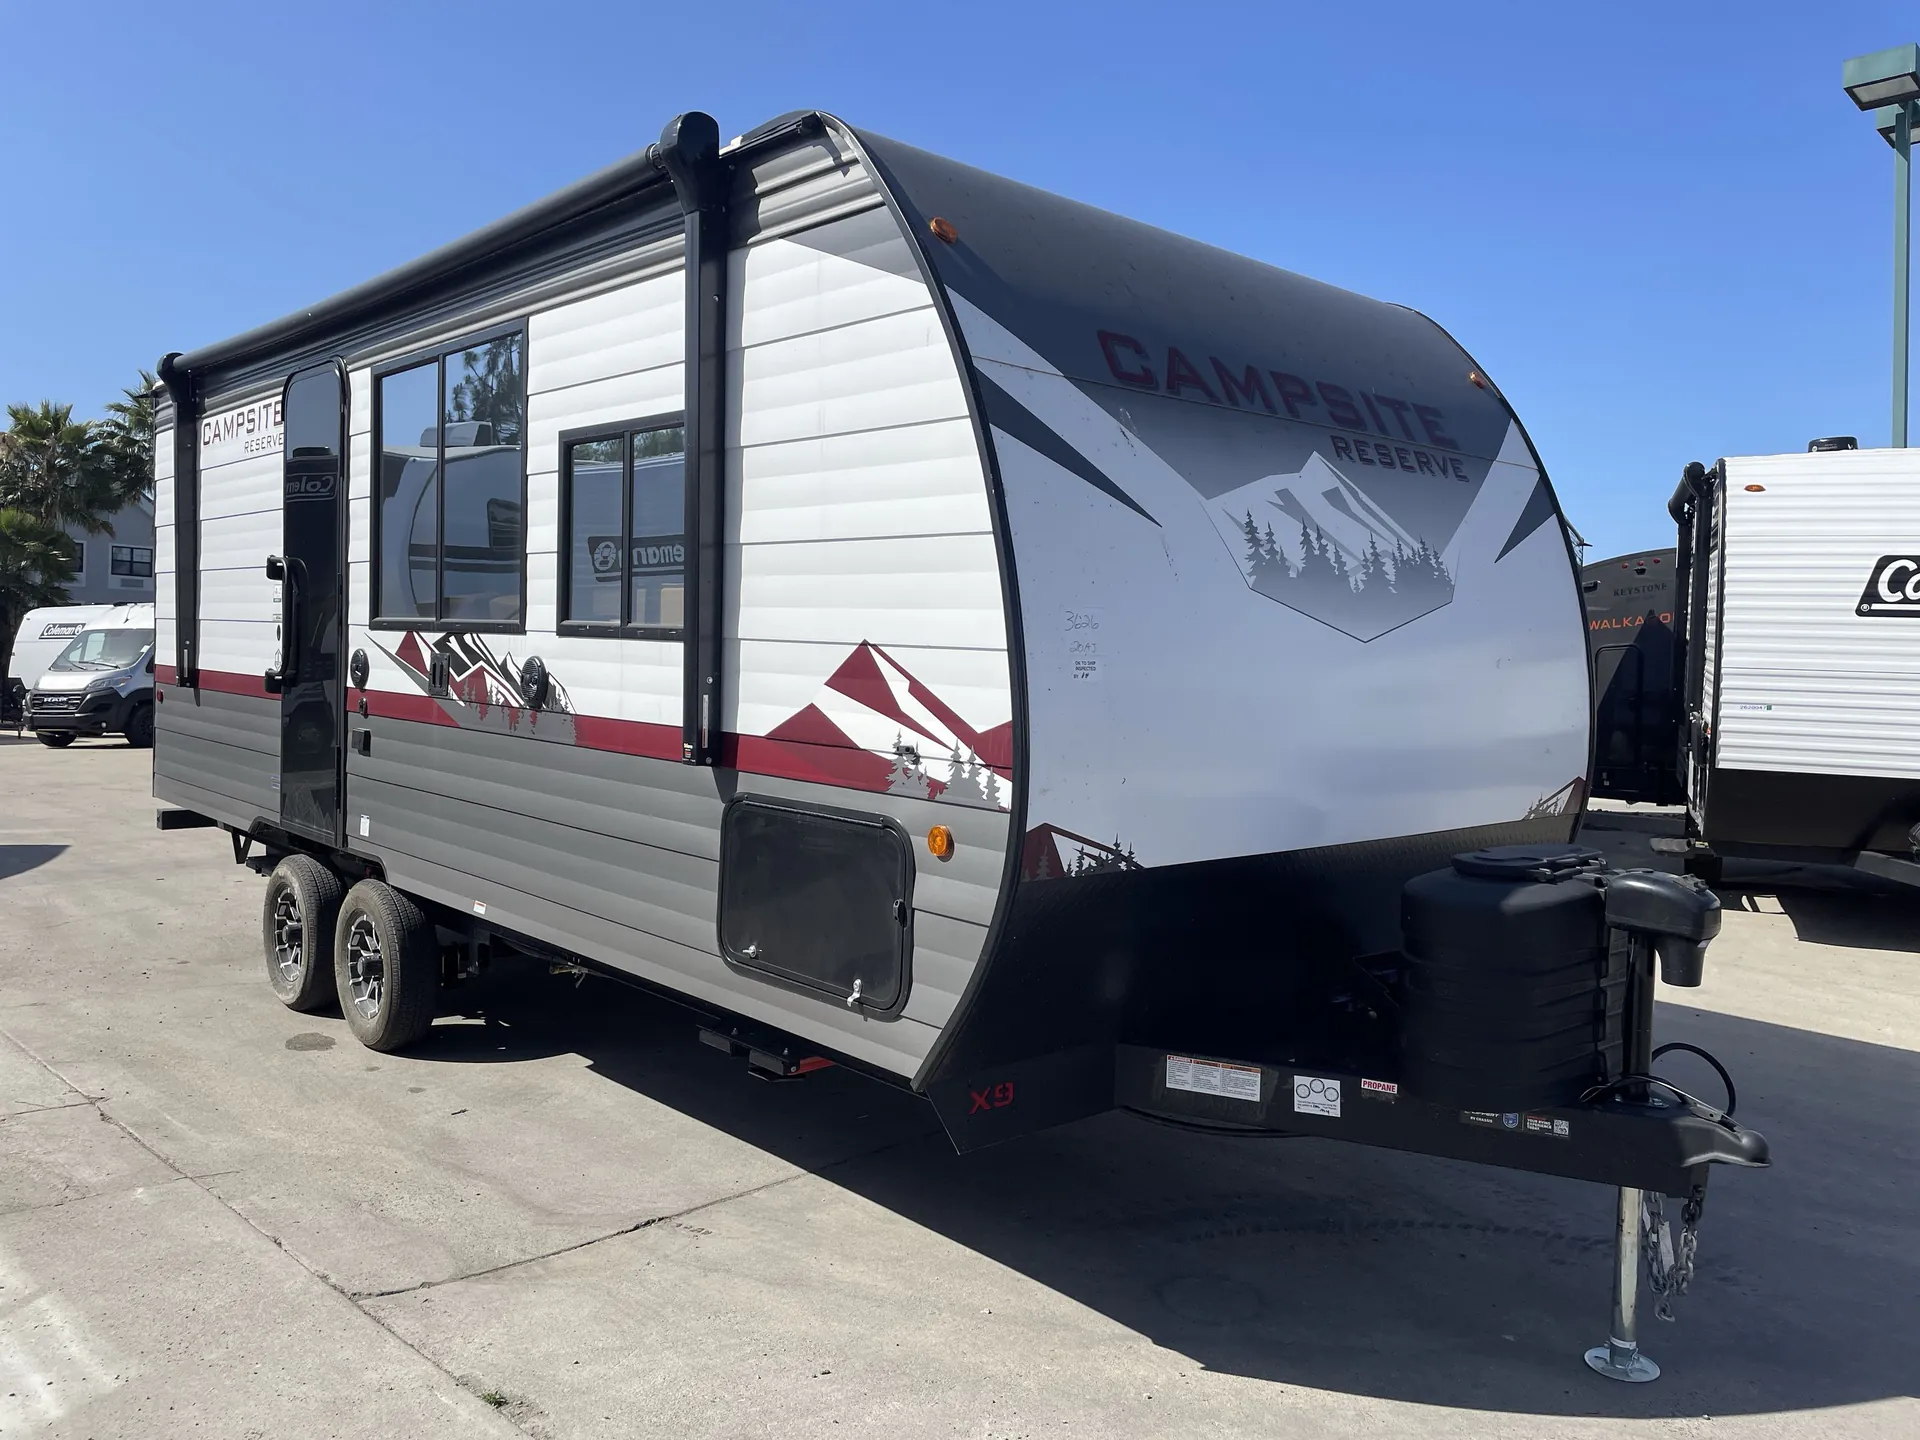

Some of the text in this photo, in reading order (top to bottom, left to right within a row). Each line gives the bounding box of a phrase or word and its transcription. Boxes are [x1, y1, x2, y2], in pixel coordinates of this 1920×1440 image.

[1097, 330, 1458, 449] CAMPSITE
[203, 401, 283, 445] CAMPSITE
[245, 433, 284, 453] RESERVE
[1330, 434, 1470, 482] RESERVE
[1613, 583, 1667, 597] KEYSTONE
[44, 625, 75, 636] Coleman
[969, 1082, 1014, 1115] X9
[1363, 1080, 1396, 1093] PROPANE
